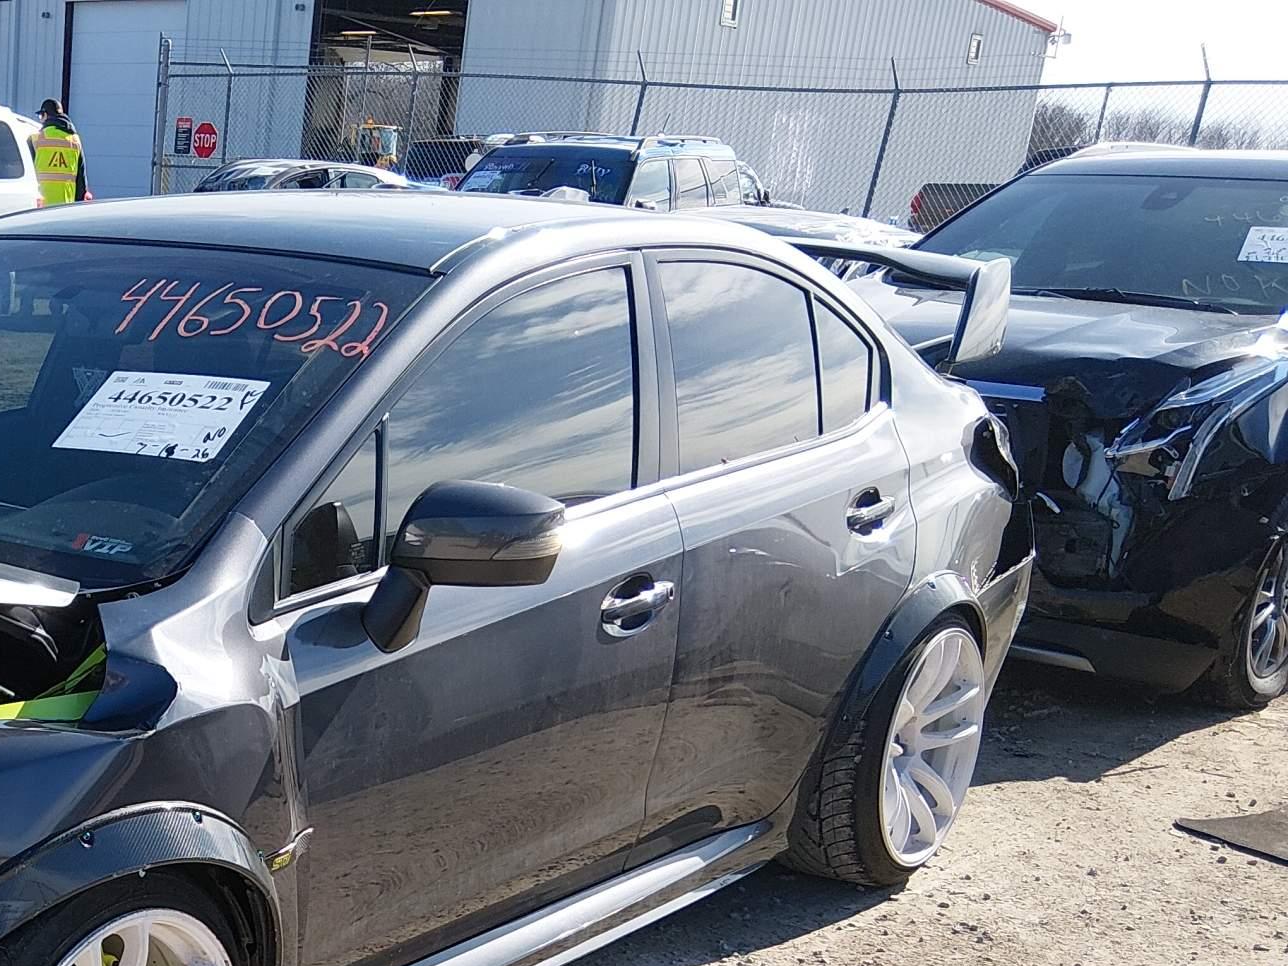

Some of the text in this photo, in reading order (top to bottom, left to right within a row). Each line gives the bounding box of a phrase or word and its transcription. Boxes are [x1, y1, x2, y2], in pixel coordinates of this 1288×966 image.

[194, 133, 217, 148] STOP
[114, 278, 388, 357] 44650522
[108, 389, 233, 411] 44650522
